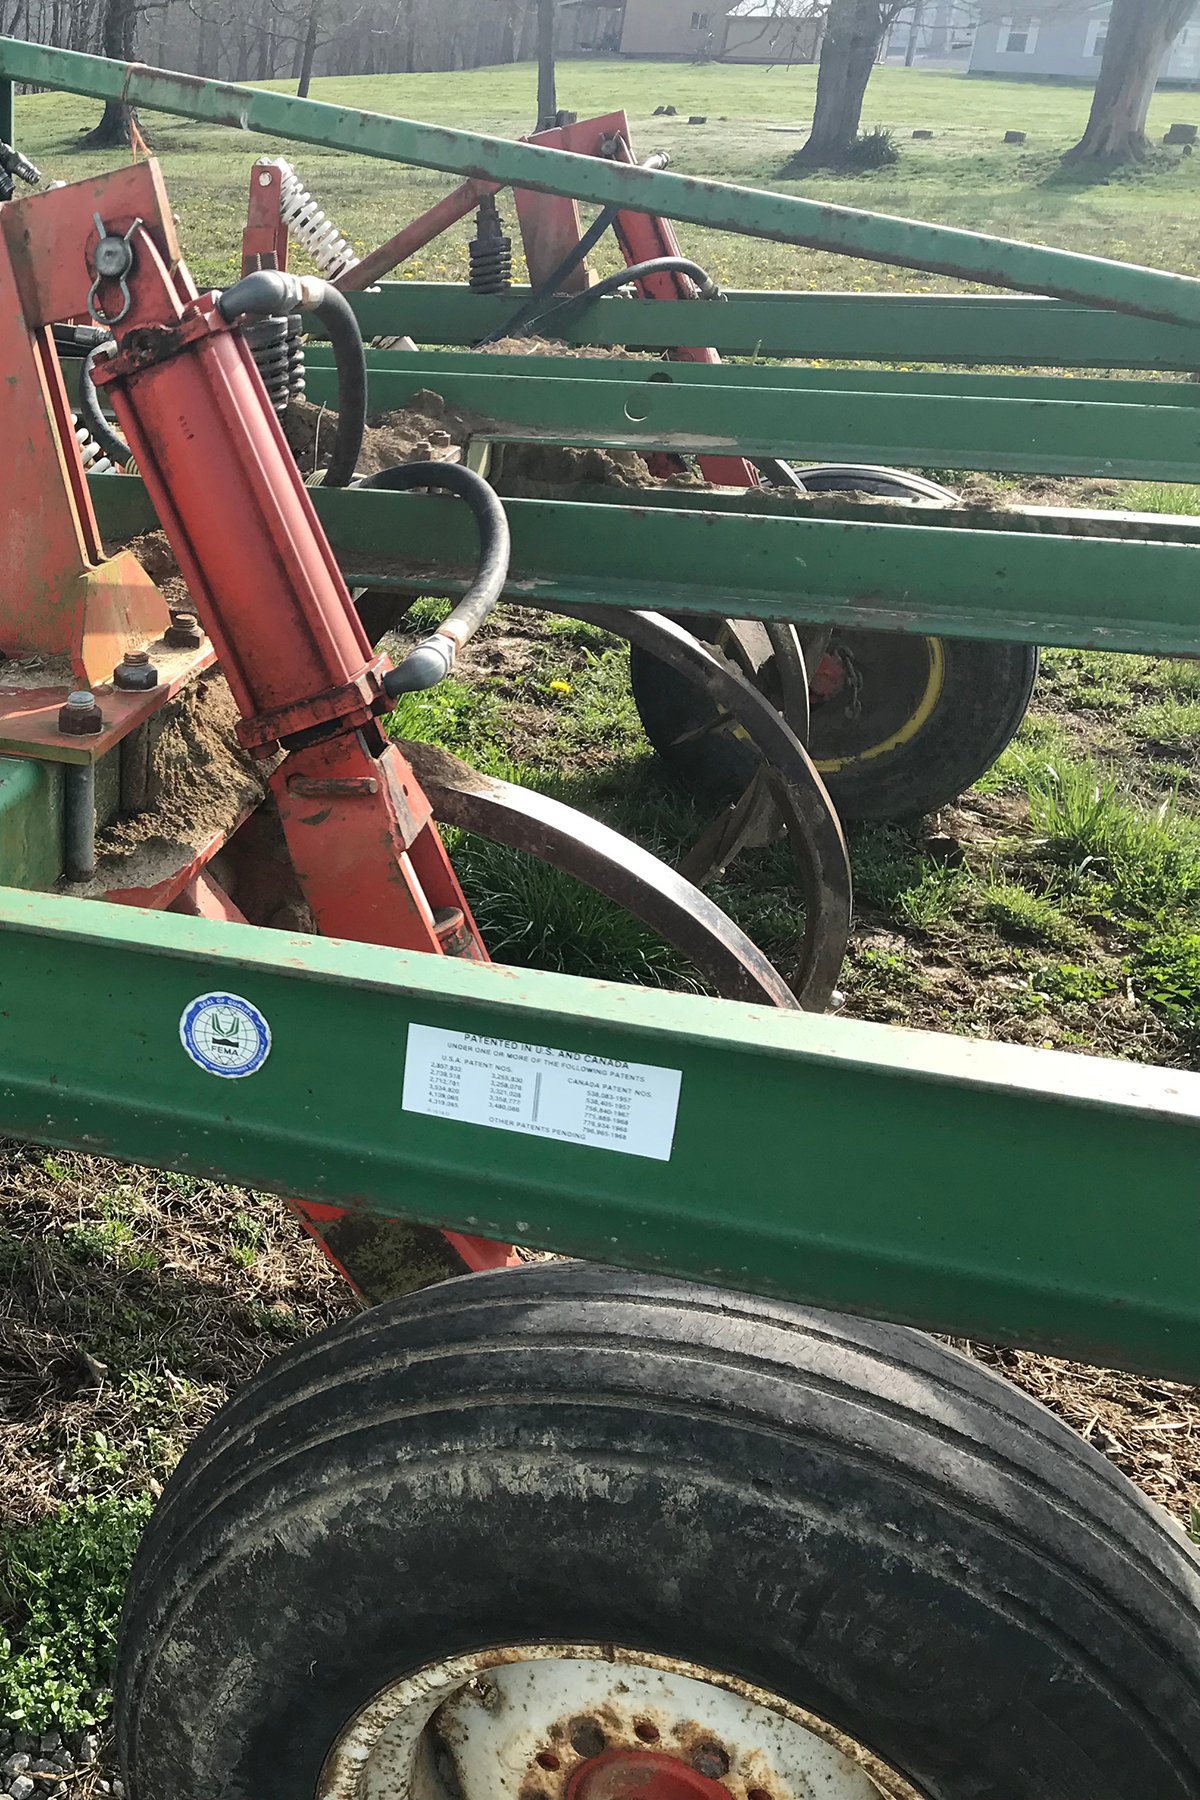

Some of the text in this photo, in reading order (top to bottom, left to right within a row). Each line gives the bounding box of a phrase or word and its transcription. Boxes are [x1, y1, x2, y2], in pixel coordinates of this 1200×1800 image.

[199, 999, 214, 1009] SEAL
[227, 999, 254, 1017] QUALITY
[211, 1045, 239, 1056] FEMA
[464, 1034, 630, 1069] PATENTED IN U.S. AND CANADA
[442, 1055, 512, 1073] U.S.A. PATENT NOS.
[447, 1042, 473, 1052] UNDER
[475, 1047, 491, 1055] ONE
[507, 1053, 529, 1062] MORE
[544, 1059, 559, 1067] THE
[561, 1063, 608, 1076] FOLLOWING
[609, 1071, 645, 1082] PATENTS
[567, 1077, 600, 1088] CANADA
[602, 1084, 632, 1094] PATENT
[489, 1116, 586, 1140] OTHER PATENTS PENDING
